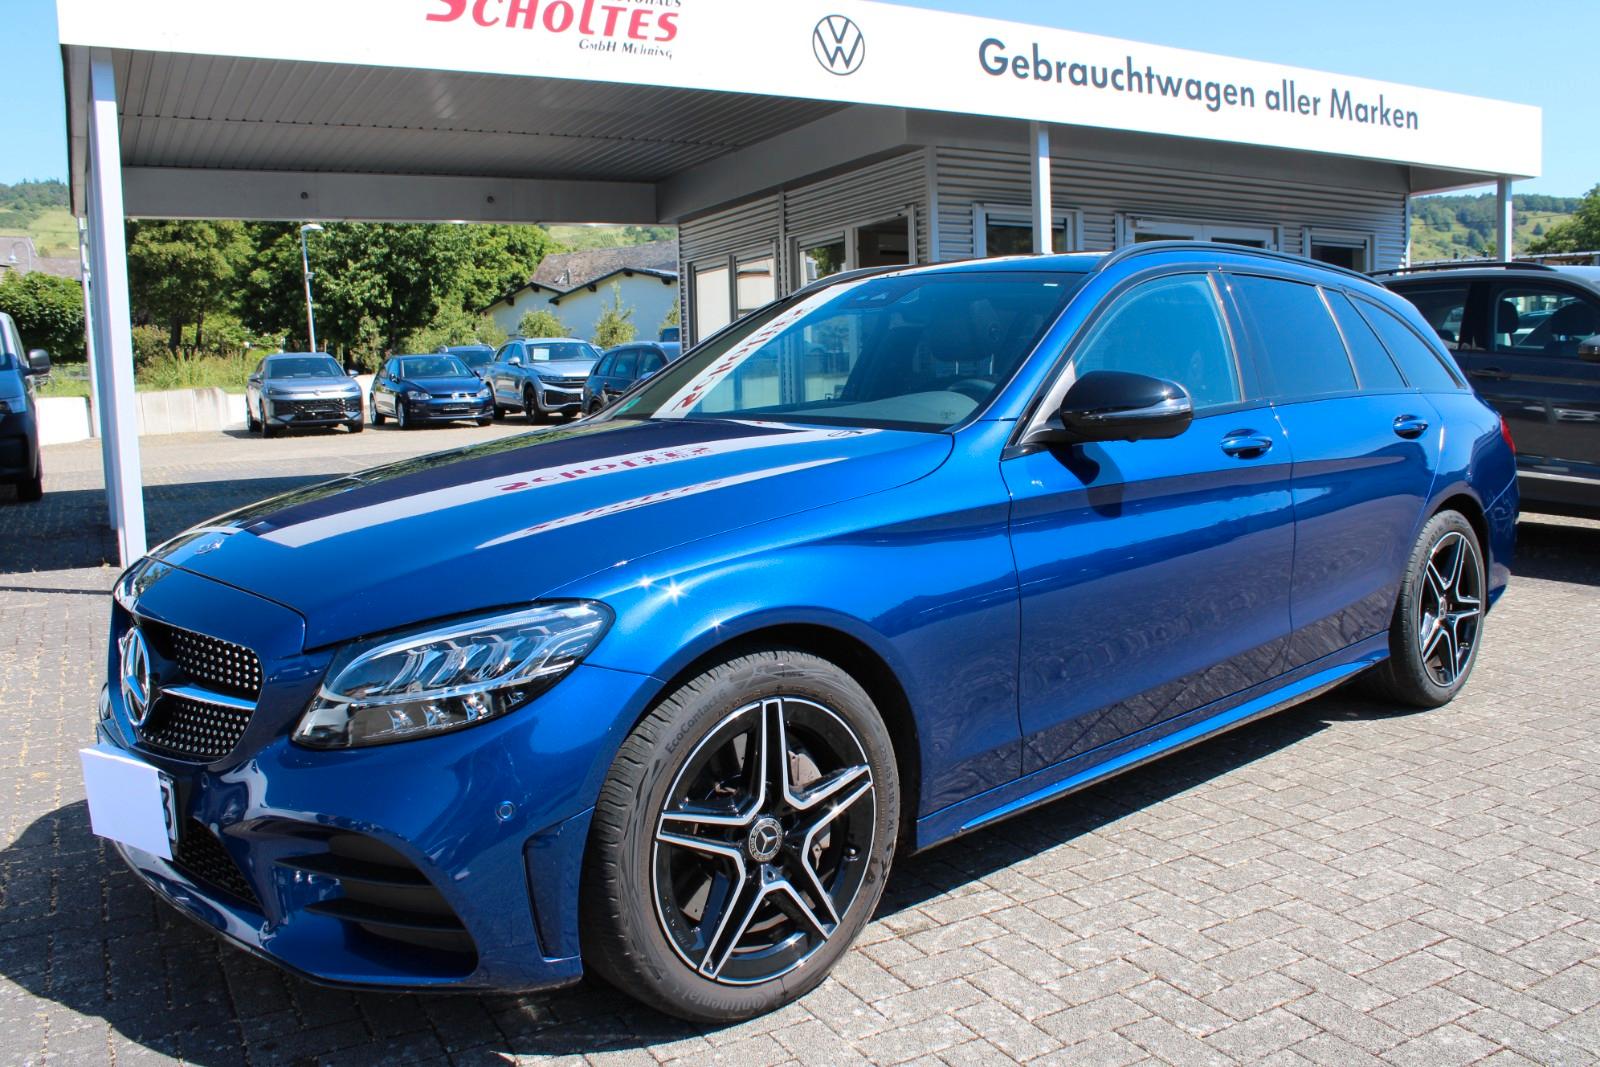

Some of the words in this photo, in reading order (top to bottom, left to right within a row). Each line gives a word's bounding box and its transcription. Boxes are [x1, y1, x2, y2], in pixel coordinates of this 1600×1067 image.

[579, 39, 617, 53] GmbH
[978, 37, 1255, 112] Gebrauchtwagen
[1265, 79, 1321, 116] aller
[1330, 88, 1419, 130] Marken
[681, 988, 768, 1012] Continental
